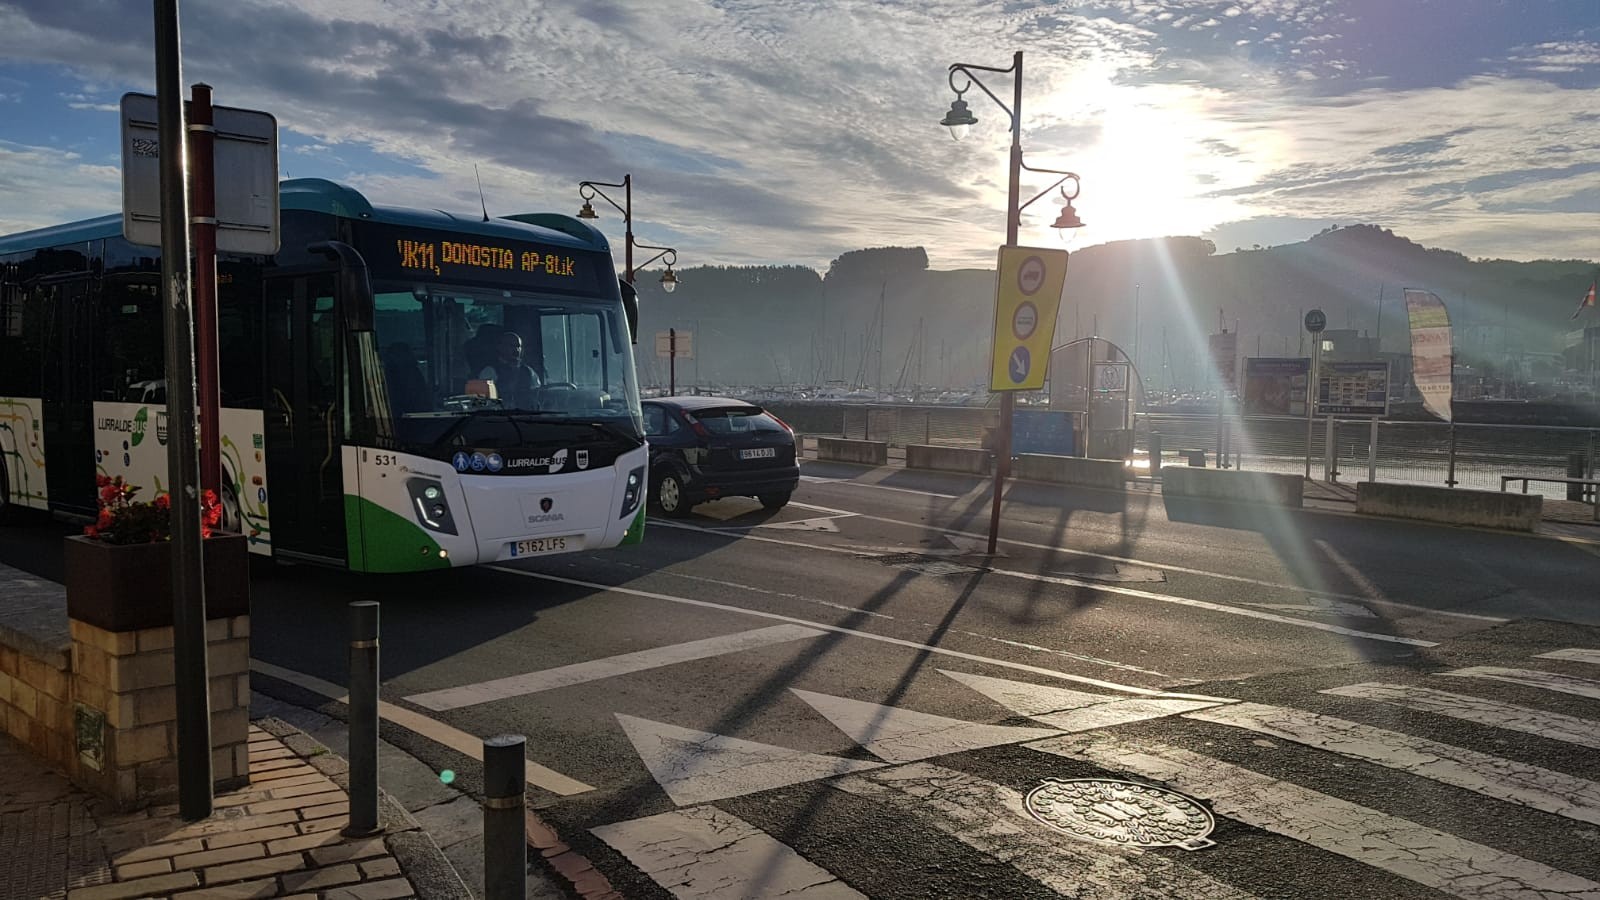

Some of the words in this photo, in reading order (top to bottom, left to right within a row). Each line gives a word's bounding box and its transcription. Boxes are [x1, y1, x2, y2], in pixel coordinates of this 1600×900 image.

[441, 241, 514, 269] DONOSTIA
[375, 455, 397, 467] 531
[527, 513, 565, 524] SCANIA
[518, 540, 544, 554] 5162
[546, 538, 566, 551] LFS
